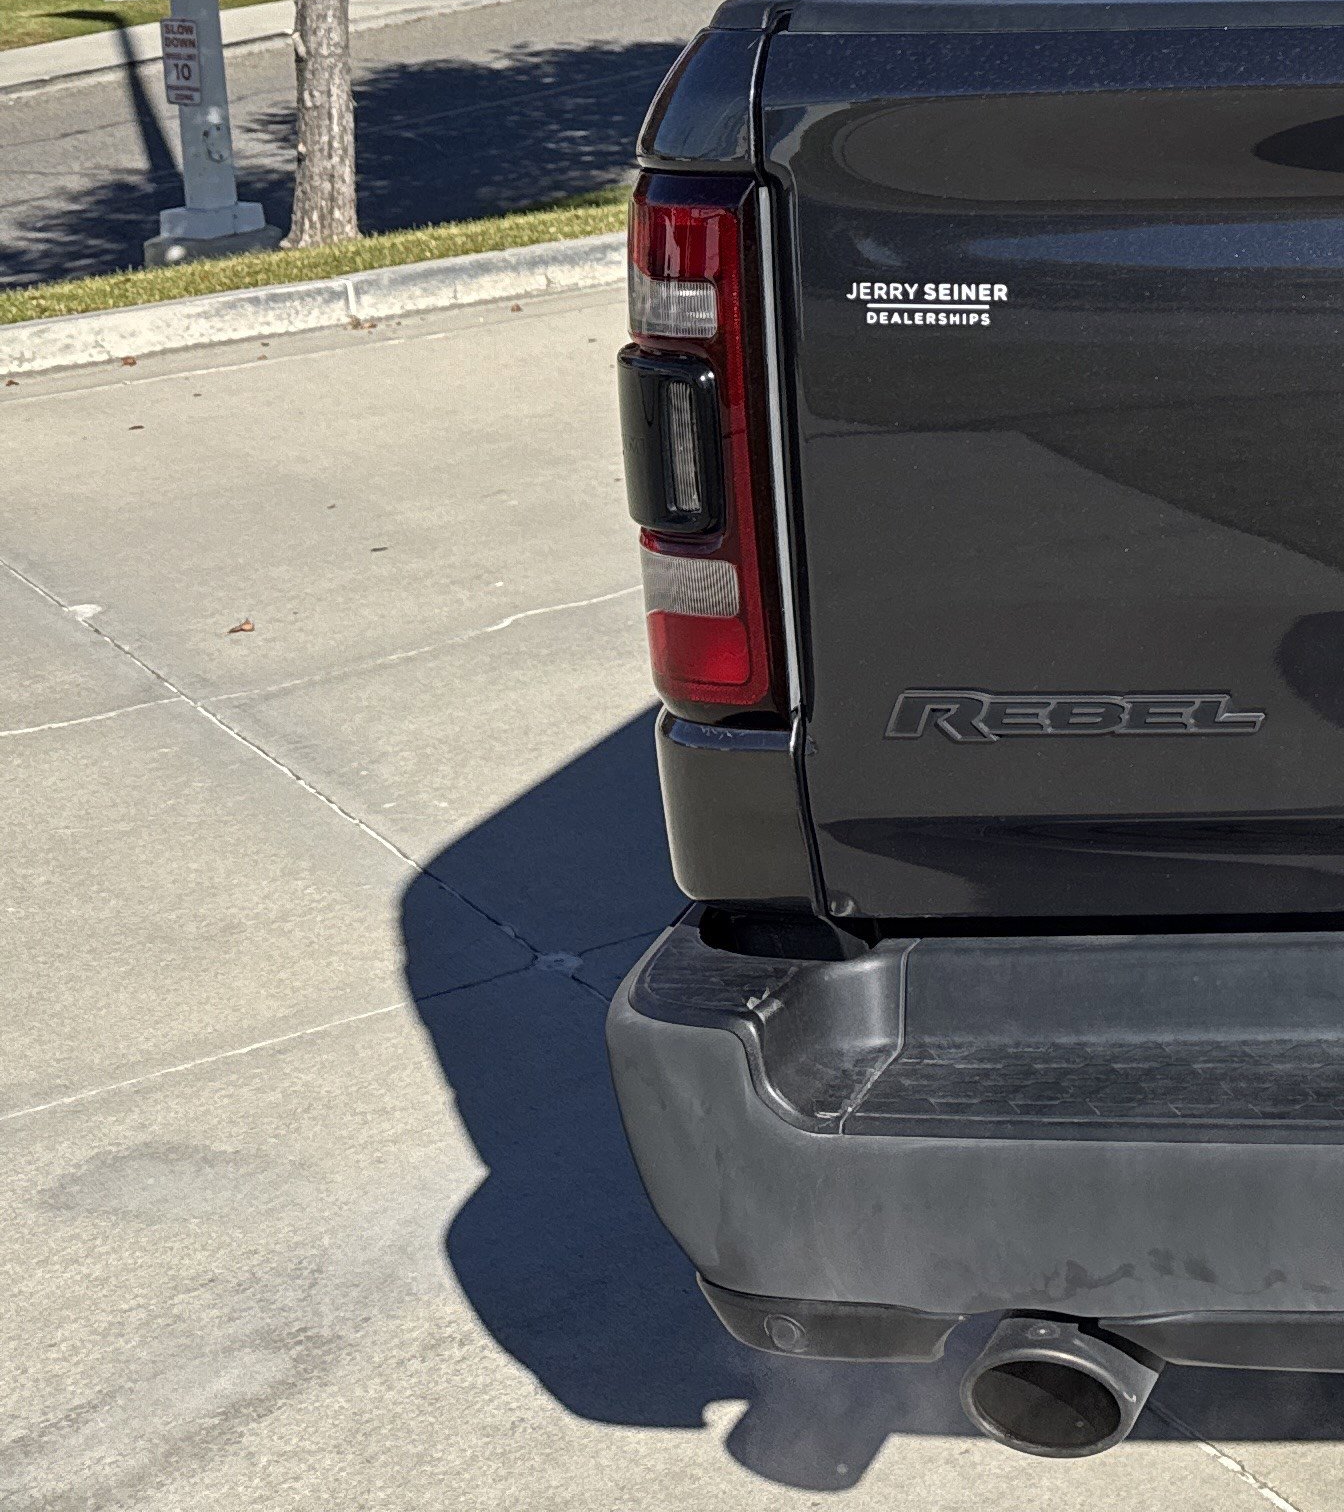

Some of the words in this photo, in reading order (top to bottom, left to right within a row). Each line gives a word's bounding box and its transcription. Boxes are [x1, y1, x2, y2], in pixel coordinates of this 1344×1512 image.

[164, 23, 194, 35] SLOW
[164, 37, 196, 48] DOWN
[173, 63, 192, 81] 10
[846, 282, 918, 300] JERRY
[923, 283, 1008, 301] SEINER
[866, 312, 990, 326] DEALERSHIPS
[885, 689, 1266, 743] REBEL
